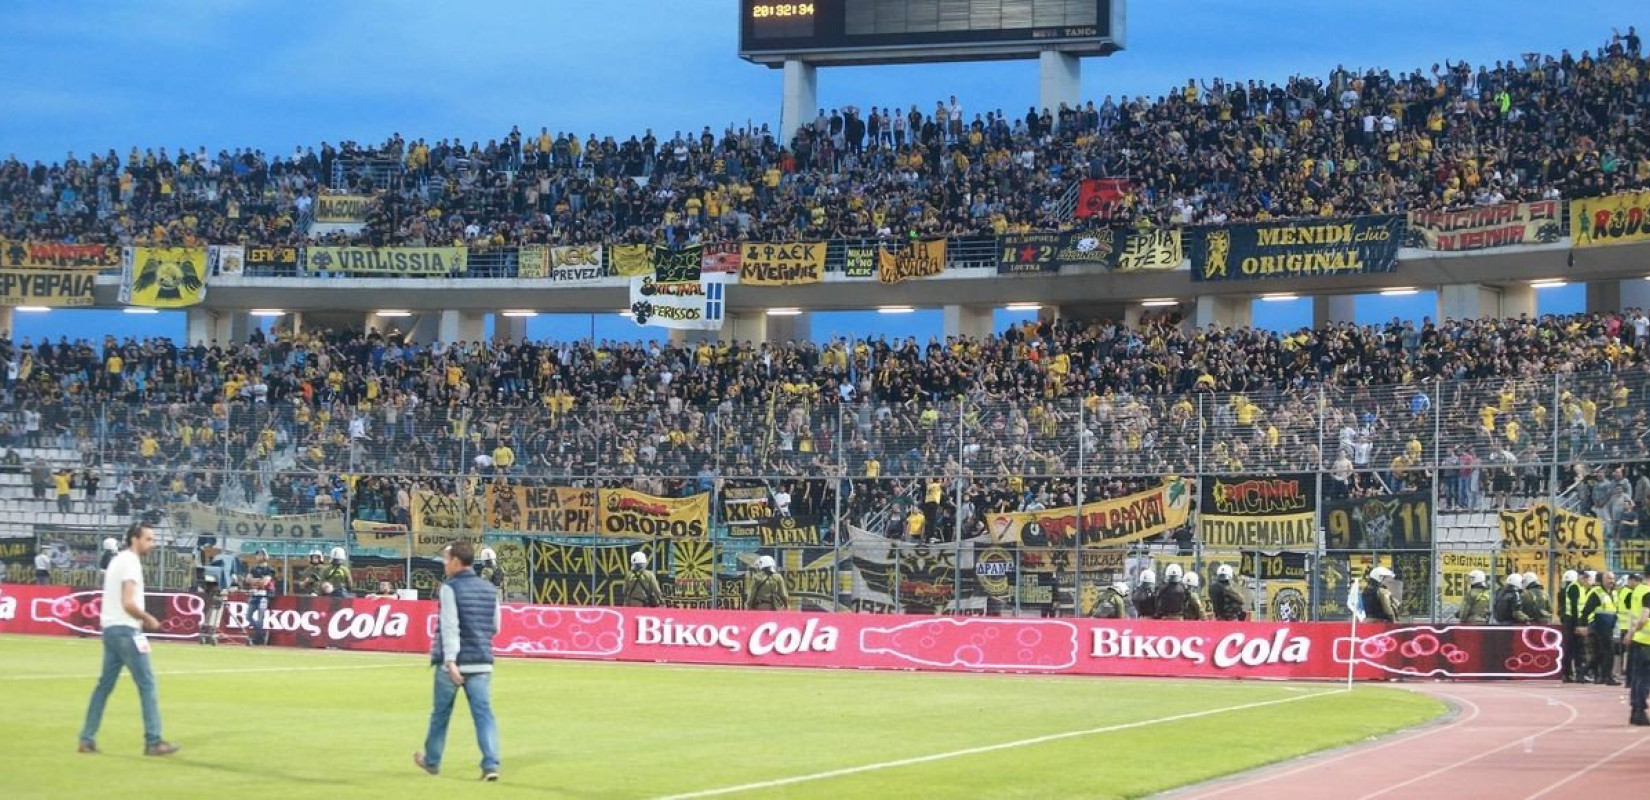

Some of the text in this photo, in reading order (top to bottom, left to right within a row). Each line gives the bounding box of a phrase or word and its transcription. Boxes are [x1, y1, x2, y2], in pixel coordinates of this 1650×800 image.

[1256, 224, 1389, 246] MENIDI club
[246, 248, 297, 258] LEFKSIA
[337, 250, 446, 271] VRILISSIA
[1242, 250, 1363, 275] ORIGINAL
[553, 268, 602, 281] PREVEZA
[652, 304, 701, 320] PERISSOS
[525, 488, 560, 509] ΝΕΑ
[605, 513, 703, 537] OROPOS
[761, 525, 819, 546] RAFINA
[1201, 517, 1316, 546] ΠΤΟΛΕΜΑΙΔΑΣ
[1328, 500, 1429, 549] 9 11
[1443, 555, 1490, 568] ORIGINAL
[226, 601, 409, 640] Βκος Cola
[634, 615, 839, 656] Βίκος Cola
[1090, 627, 1312, 668] Βίκος Cola
